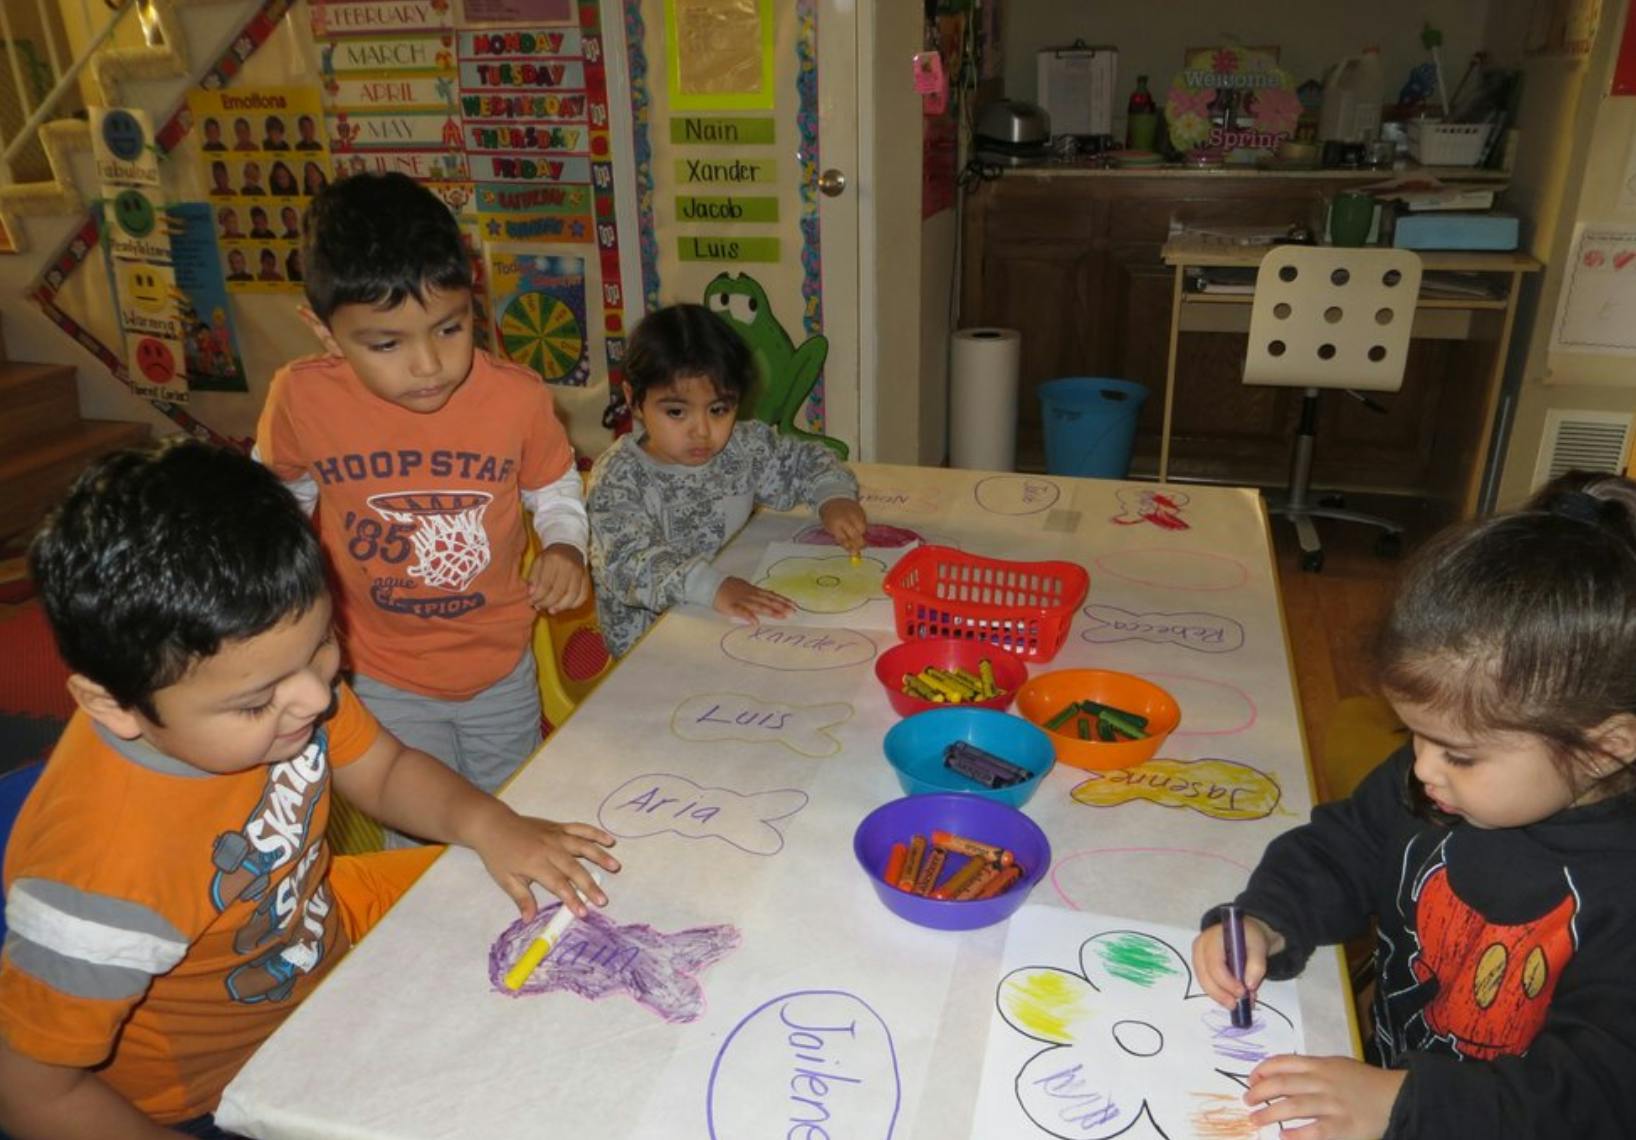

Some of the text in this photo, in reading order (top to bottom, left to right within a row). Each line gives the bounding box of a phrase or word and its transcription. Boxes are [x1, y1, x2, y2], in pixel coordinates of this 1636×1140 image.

[334, 4, 430, 25] FEBRUARY
[347, 43, 427, 64] MARCH
[474, 31, 564, 55] MONDAY
[477, 64, 566, 86] TUESDAY
[221, 93, 288, 110] Emotions
[360, 82, 413, 102] APRIL
[462, 95, 586, 118] WEDNESDAY
[367, 119, 417, 138] MAY
[472, 127, 581, 151] THURSDAY
[684, 119, 739, 141] Nain
[375, 155, 423, 174] JUNE
[492, 159, 565, 181] FRIDAY
[687, 158, 761, 183] Xander
[682, 199, 743, 219] Jacob
[693, 237, 740, 260] Luis
[314, 450, 423, 485] HOOP
[1112, 619, 1225, 641] Rebecca
[695, 704, 793, 730] Luis
[614, 786, 721, 824] Aria
[779, 1002, 862, 1140] Jailene
